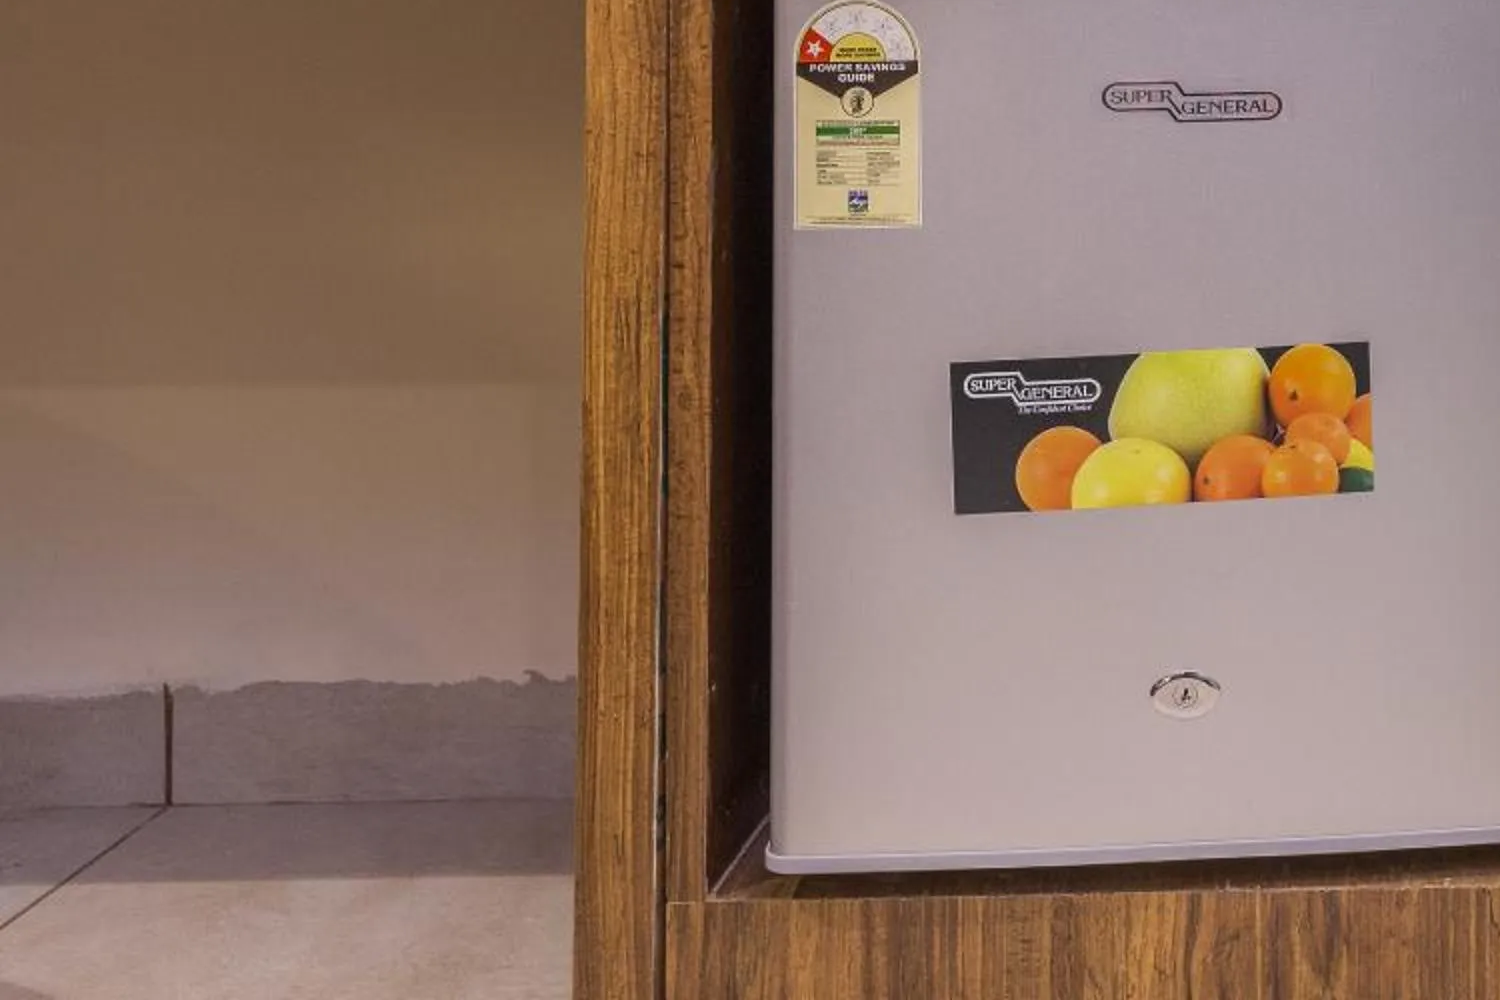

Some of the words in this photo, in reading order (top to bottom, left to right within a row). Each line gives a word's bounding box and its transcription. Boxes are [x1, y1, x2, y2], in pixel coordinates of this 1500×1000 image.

[809, 63, 853, 73] POWER
[854, 62, 906, 72] SAVINGS
[837, 73, 876, 83] GUIDE
[1109, 89, 1173, 104] SUPER
[1181, 99, 1275, 115] GENERAL
[970, 377, 1017, 392] SUPER
[1020, 385, 1093, 400] GENERAL
